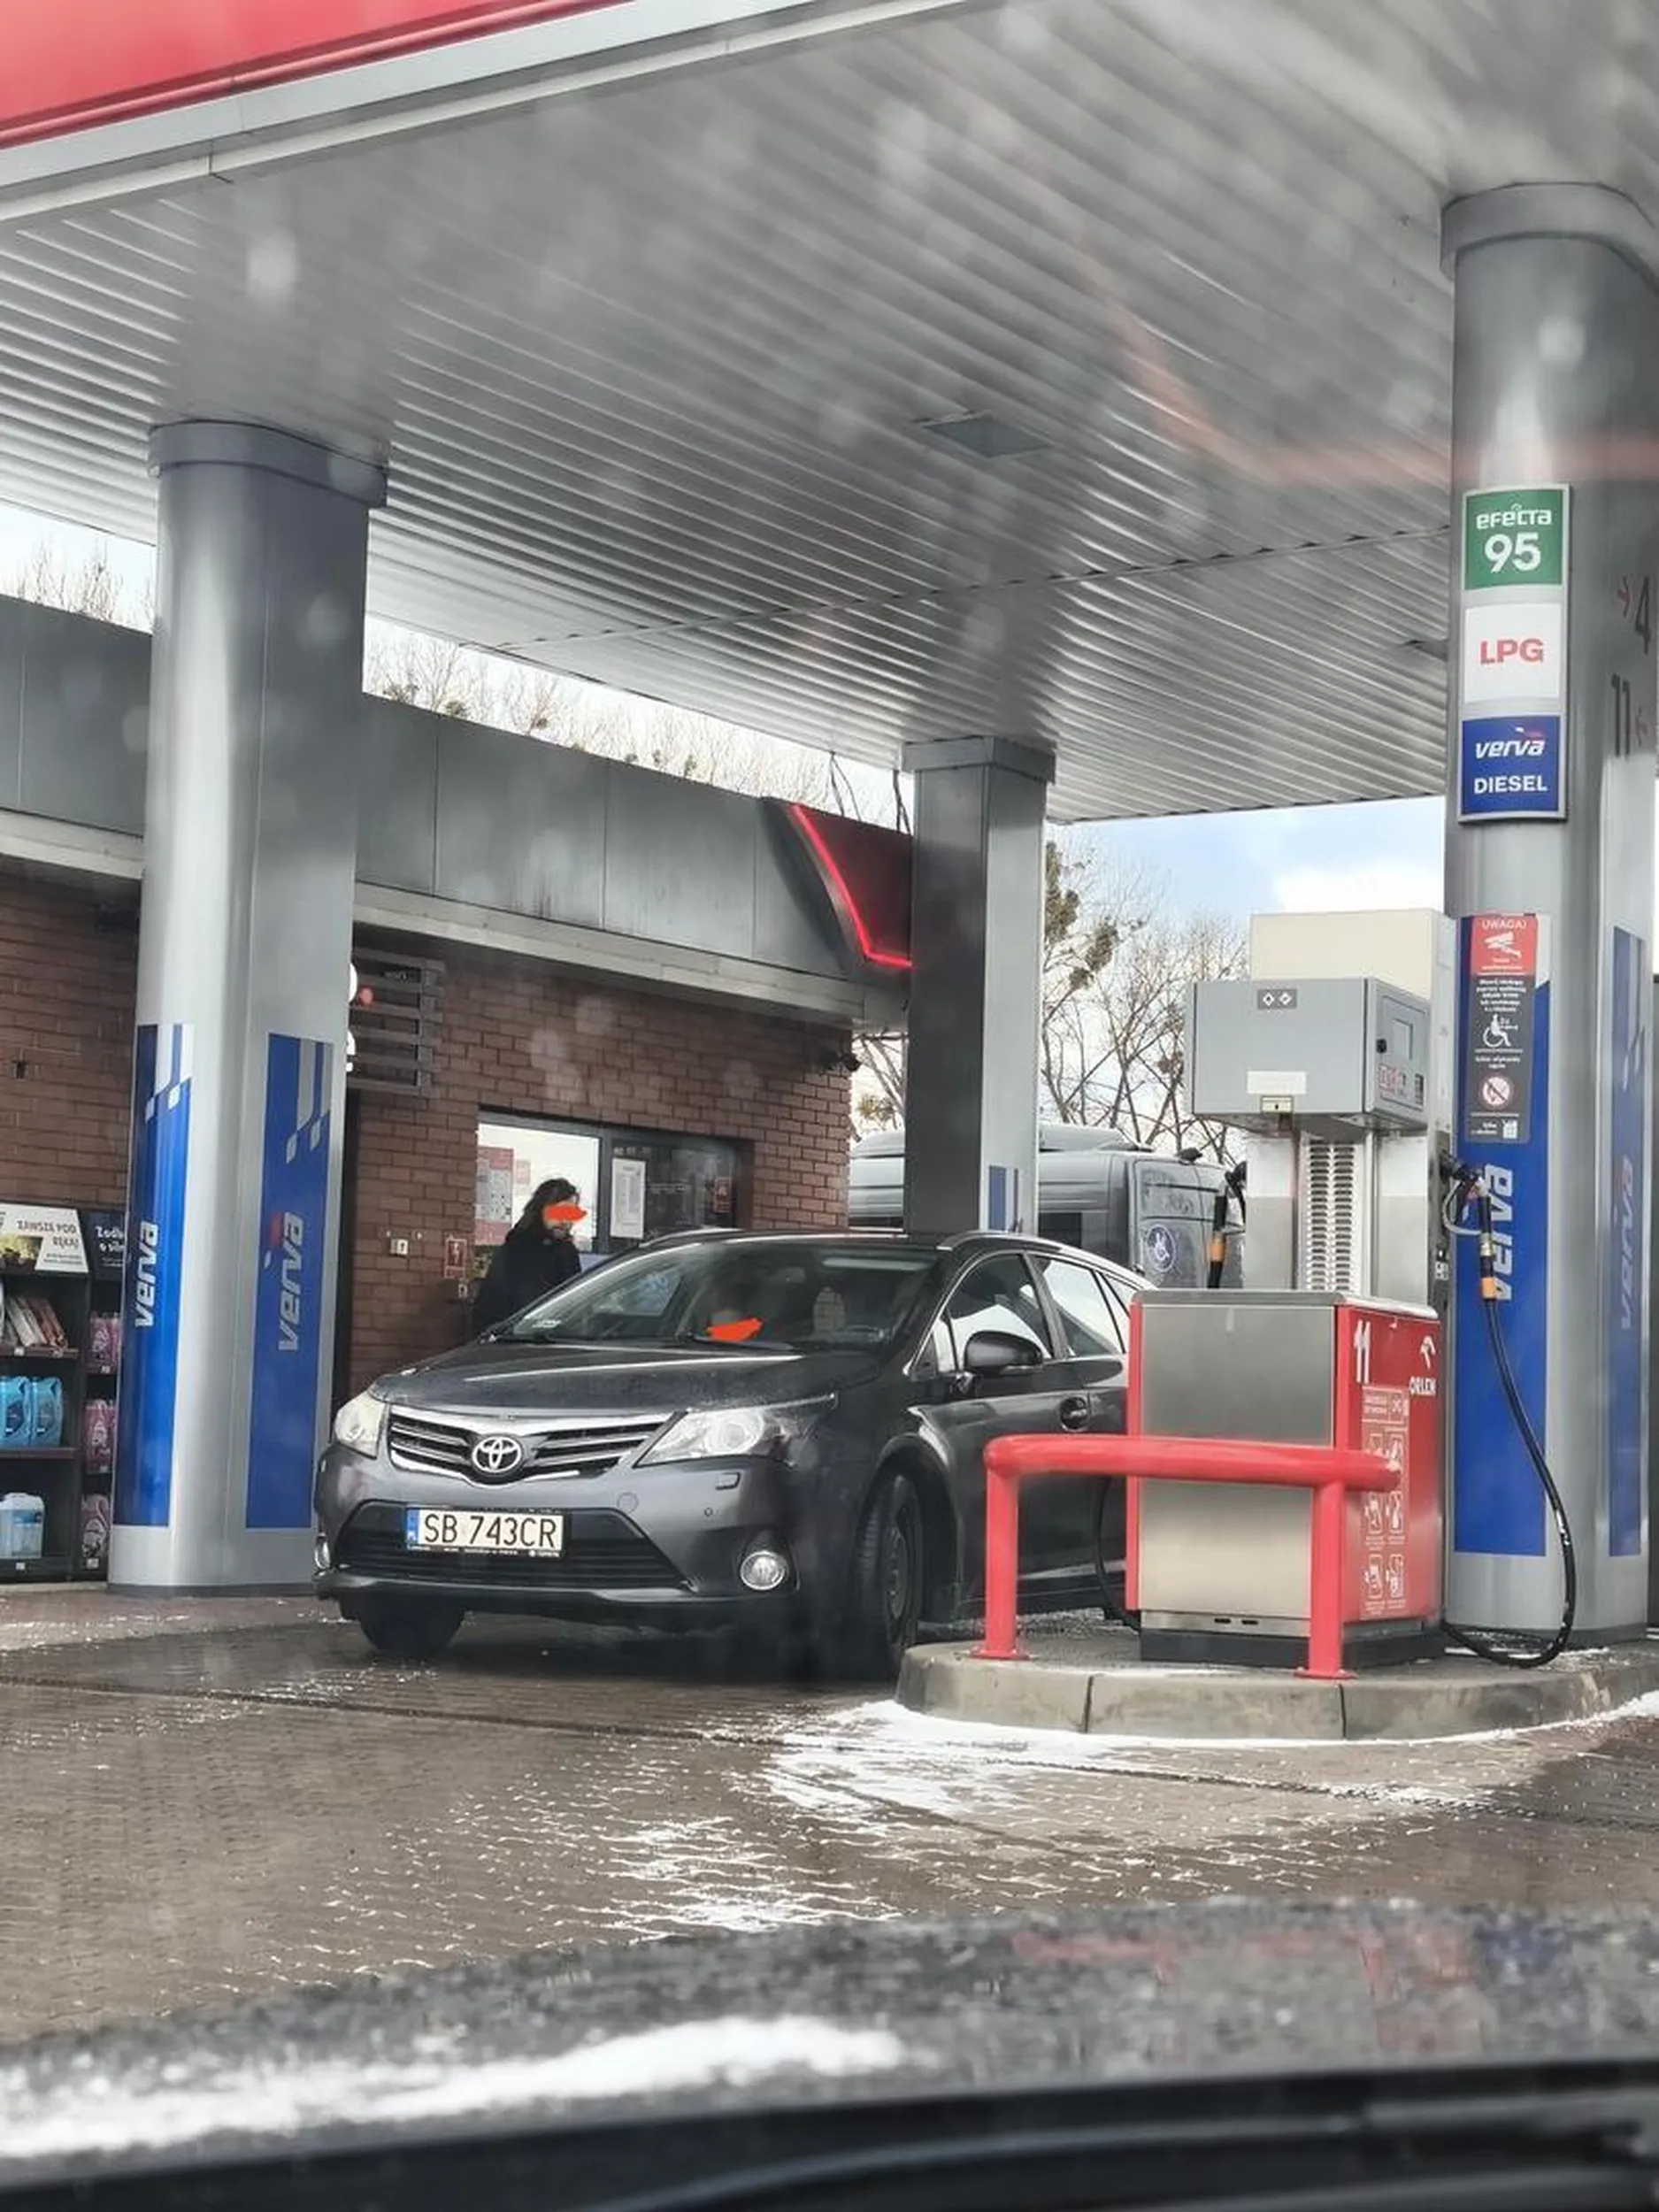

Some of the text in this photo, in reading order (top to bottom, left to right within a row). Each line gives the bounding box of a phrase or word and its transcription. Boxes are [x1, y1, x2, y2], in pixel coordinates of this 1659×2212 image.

[1484, 533, 1541, 573] 95
[1479, 638, 1544, 664] LPG
[1475, 740, 1546, 759] verva
[1474, 775, 1548, 795] DIESEL
[1481, 918, 1527, 930] UWAGA!
[134, 1220, 158, 1327] verva
[279, 1212, 303, 1351] verva
[1353, 1319, 1371, 1385] 11
[1409, 1376, 1437, 1395] ORLEN
[424, 1514, 457, 1543] SB
[470, 1515, 557, 1547] 743CR
